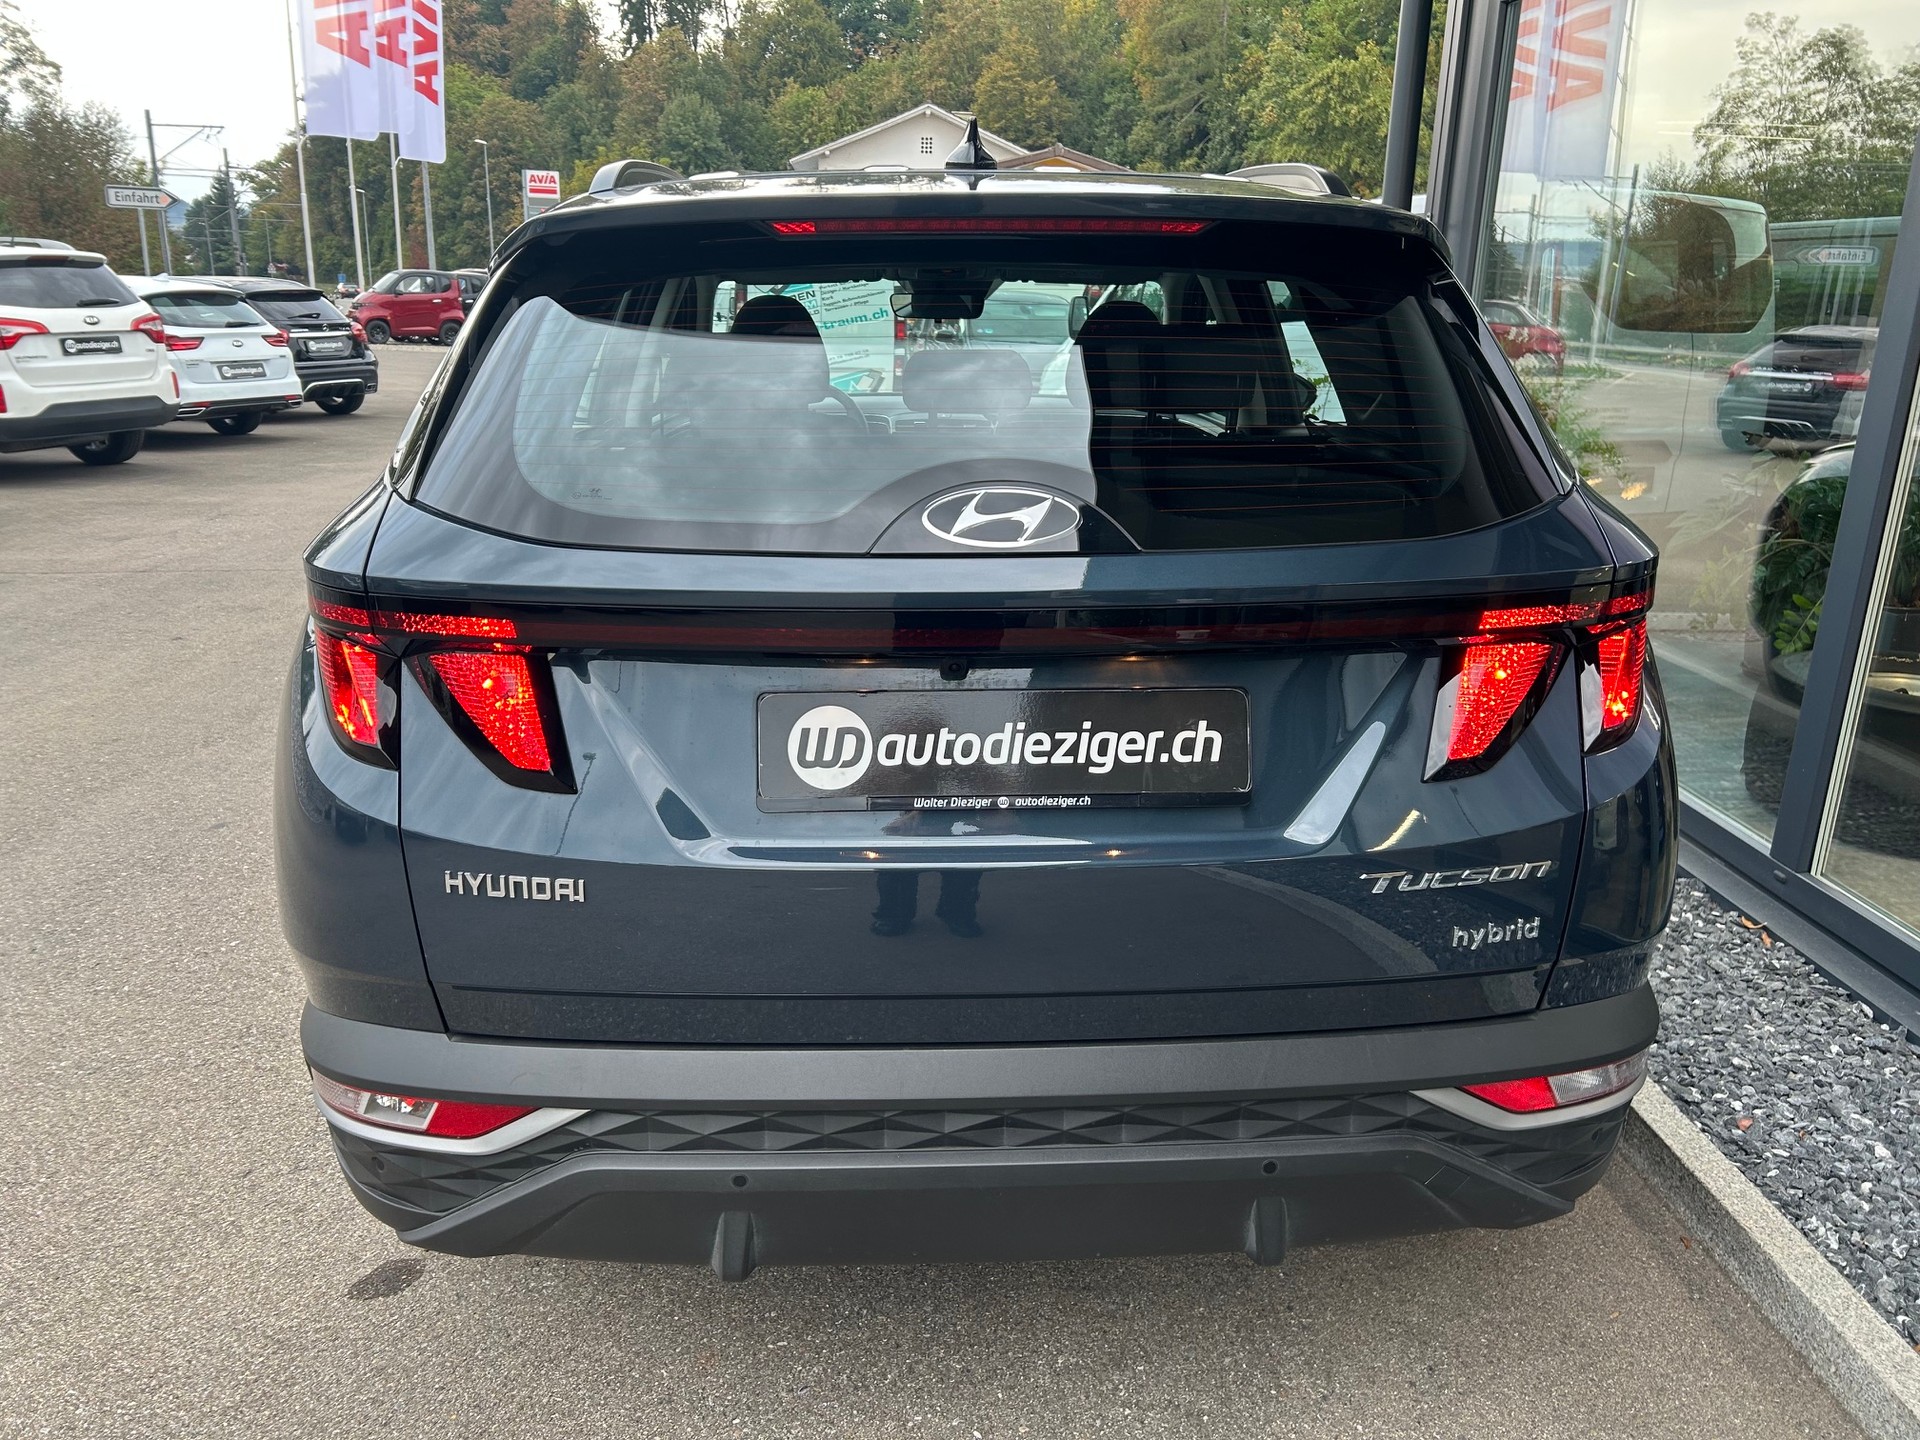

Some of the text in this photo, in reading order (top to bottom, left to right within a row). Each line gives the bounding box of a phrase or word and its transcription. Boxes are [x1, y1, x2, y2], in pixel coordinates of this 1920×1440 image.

[412, 0, 439, 106] AVI
[114, 191, 160, 204] Einfahrt
[876, 720, 1223, 775] autodieziger.ch
[913, 797, 949, 808] Walter
[950, 796, 993, 809] Dieziger
[1015, 795, 1092, 808] autodieziger.ch
[444, 870, 586, 903] HYUNDAI
[1359, 859, 1552, 894] TUCSON
[1451, 916, 1541, 950] hybrid
